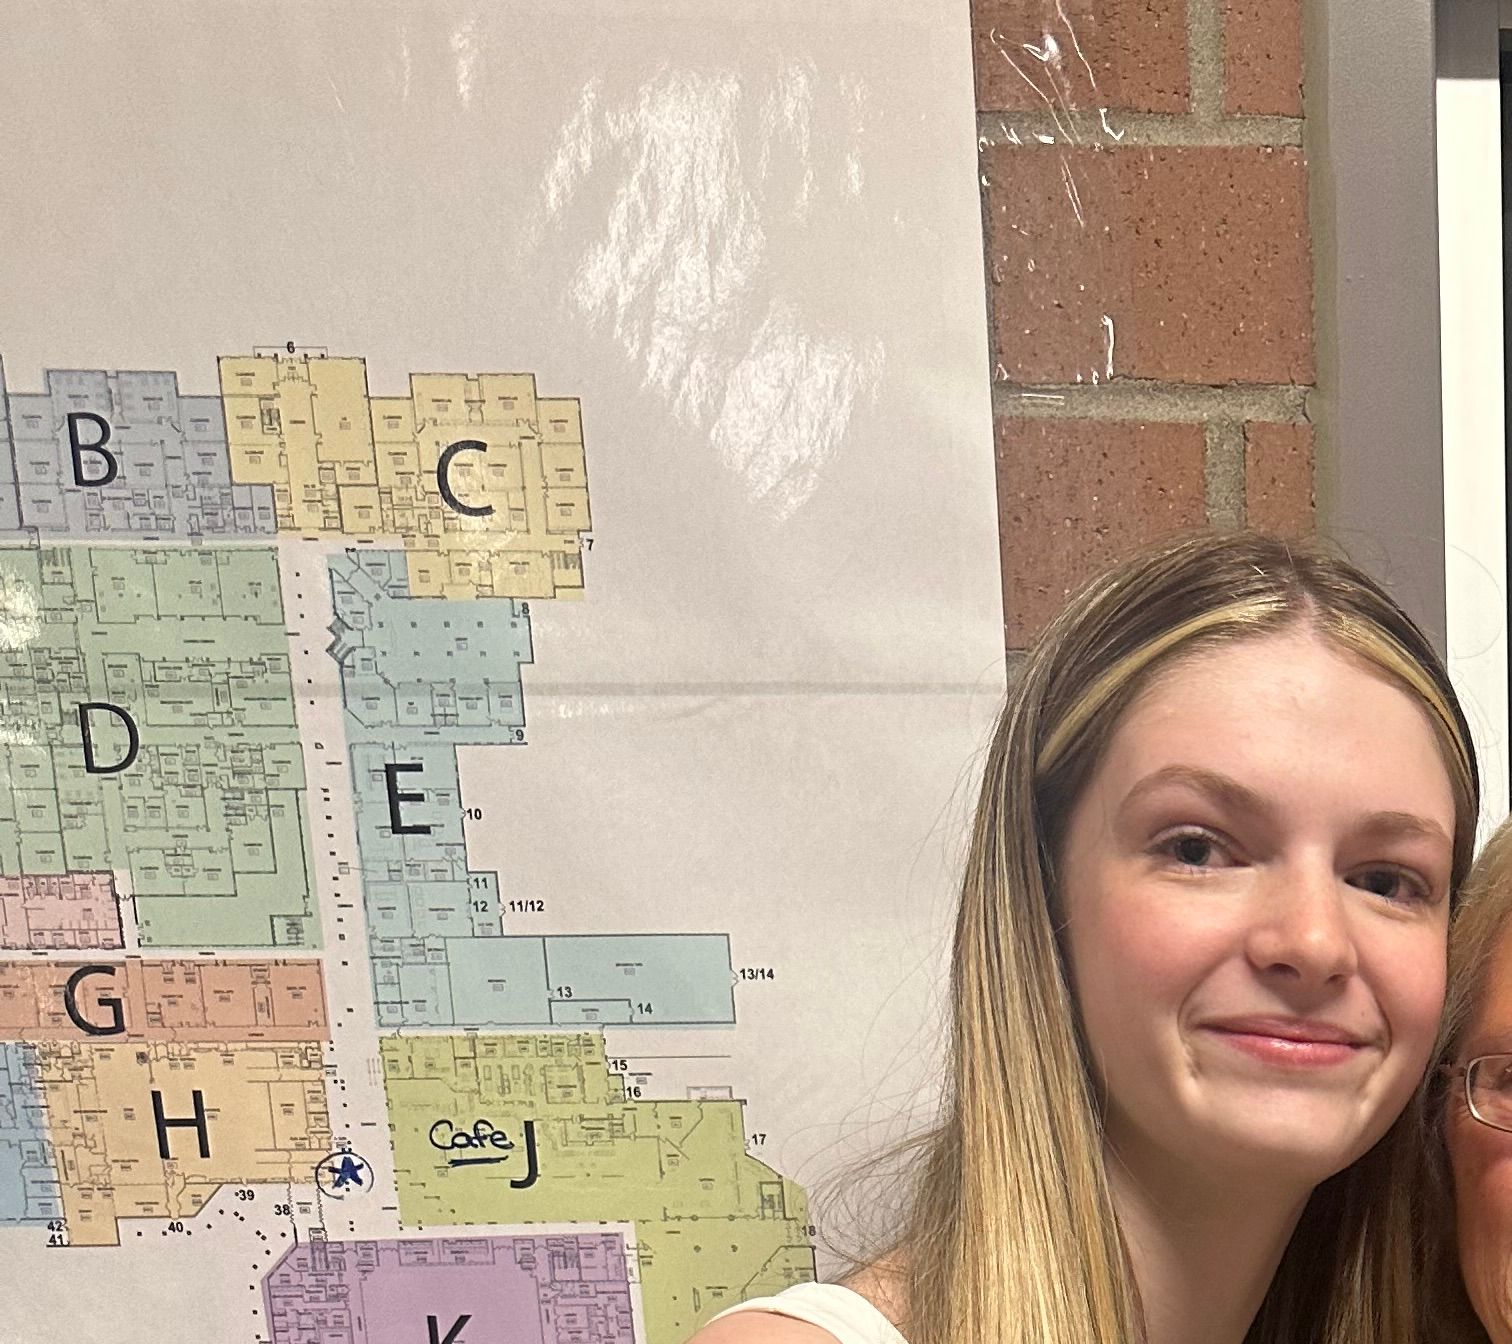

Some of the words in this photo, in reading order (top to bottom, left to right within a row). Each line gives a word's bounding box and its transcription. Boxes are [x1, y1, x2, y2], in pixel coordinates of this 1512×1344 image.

[286, 341, 296, 354] 6
[67, 412, 118, 487] B
[435, 440, 496, 517] C
[585, 538, 594, 551] 7
[521, 603, 530, 615] 8
[77, 702, 140, 774] D
[515, 729, 525, 742] 9
[386, 763, 431, 836] E
[466, 809, 482, 821] 10
[473, 878, 488, 889] 11
[472, 900, 488, 913] 12
[509, 900, 545, 913] 11/12
[739, 968, 775, 981] 13/14
[556, 986, 573, 999] 13
[65, 964, 126, 1037] G
[637, 1003, 653, 1015] 14
[611, 1059, 628, 1071] 15
[626, 1086, 642, 1098] 16
[153, 1090, 211, 1159] H
[429, 1119, 515, 1150] Cafe
[751, 1133, 767, 1146] 17
[510, 1121, 539, 1189] J
[239, 1189, 255, 1201] 39
[274, 1204, 290, 1216] 38
[47, 1221, 63, 1232] 42
[167, 1222, 184, 1233] 40
[801, 1225, 817, 1237] 18
[48, 1233, 63, 1245] 41
